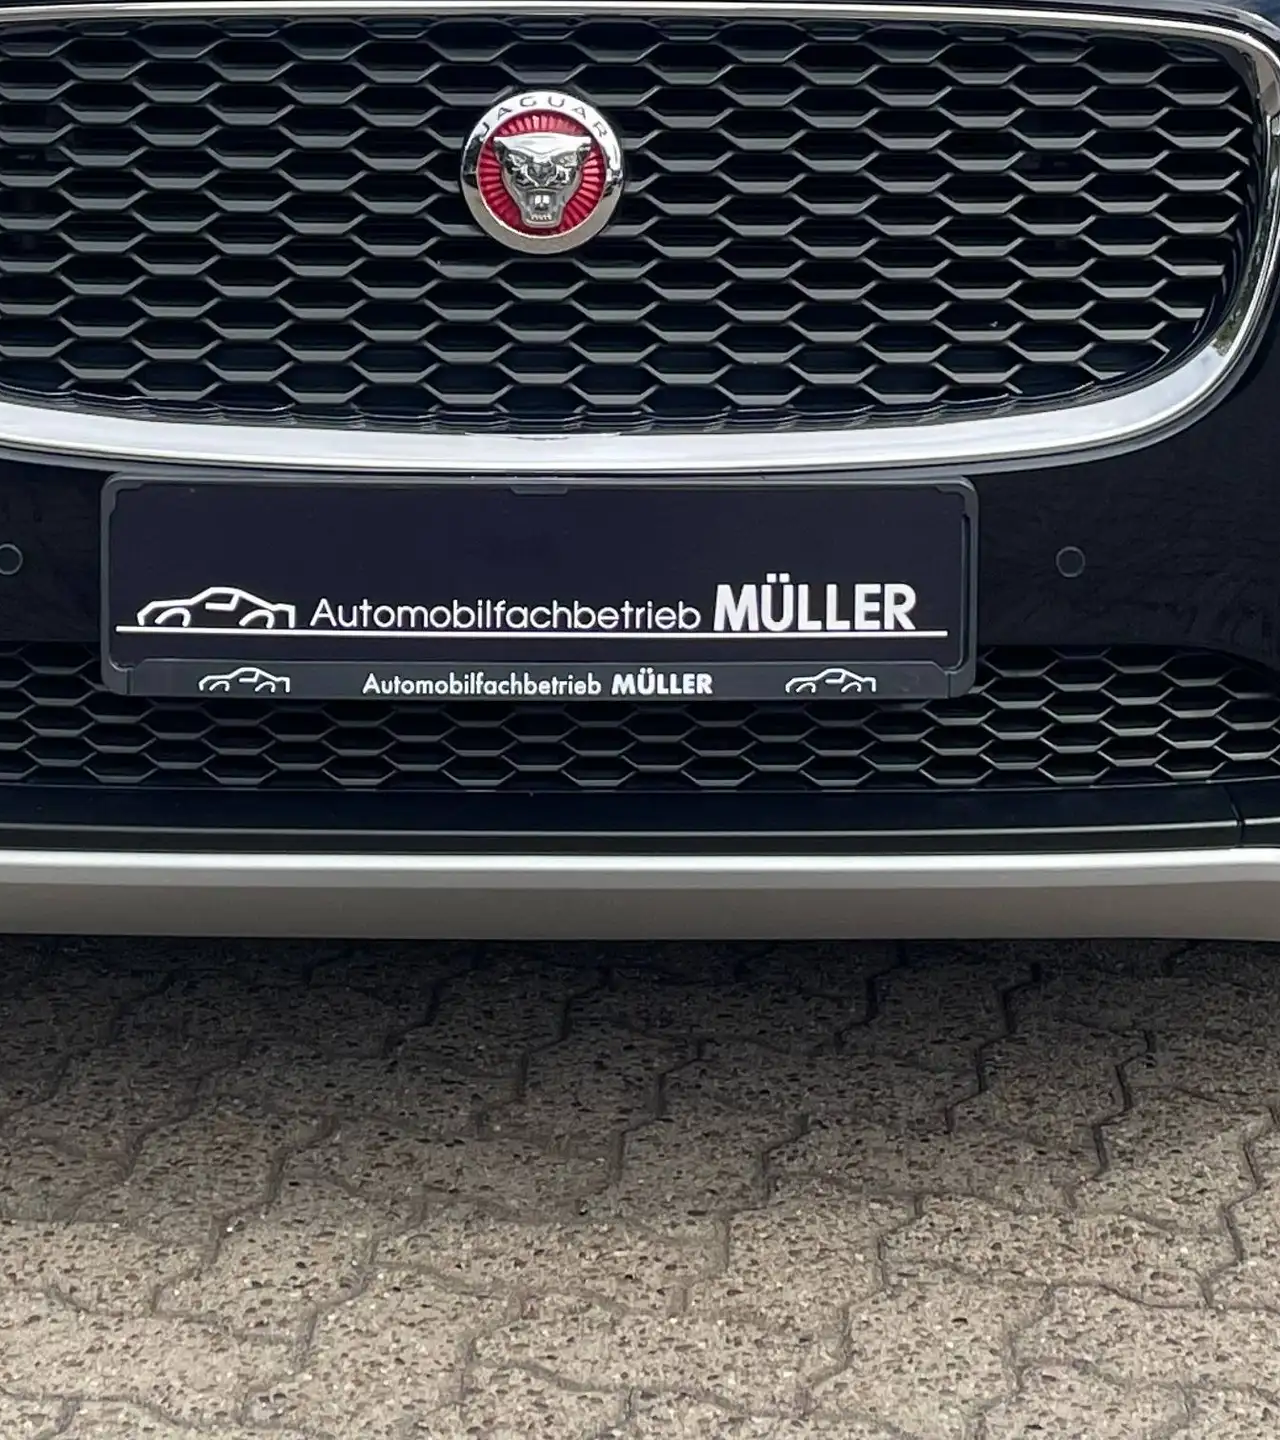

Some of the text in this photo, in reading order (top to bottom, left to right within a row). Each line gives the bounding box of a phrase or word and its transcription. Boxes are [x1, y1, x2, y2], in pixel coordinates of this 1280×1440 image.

[479, 95, 608, 141] JAGUAR
[309, 572, 918, 632] Automobilfachbetrieb MÜLLER
[361, 667, 714, 697] Automobilfachbetrieb MÜLLER
